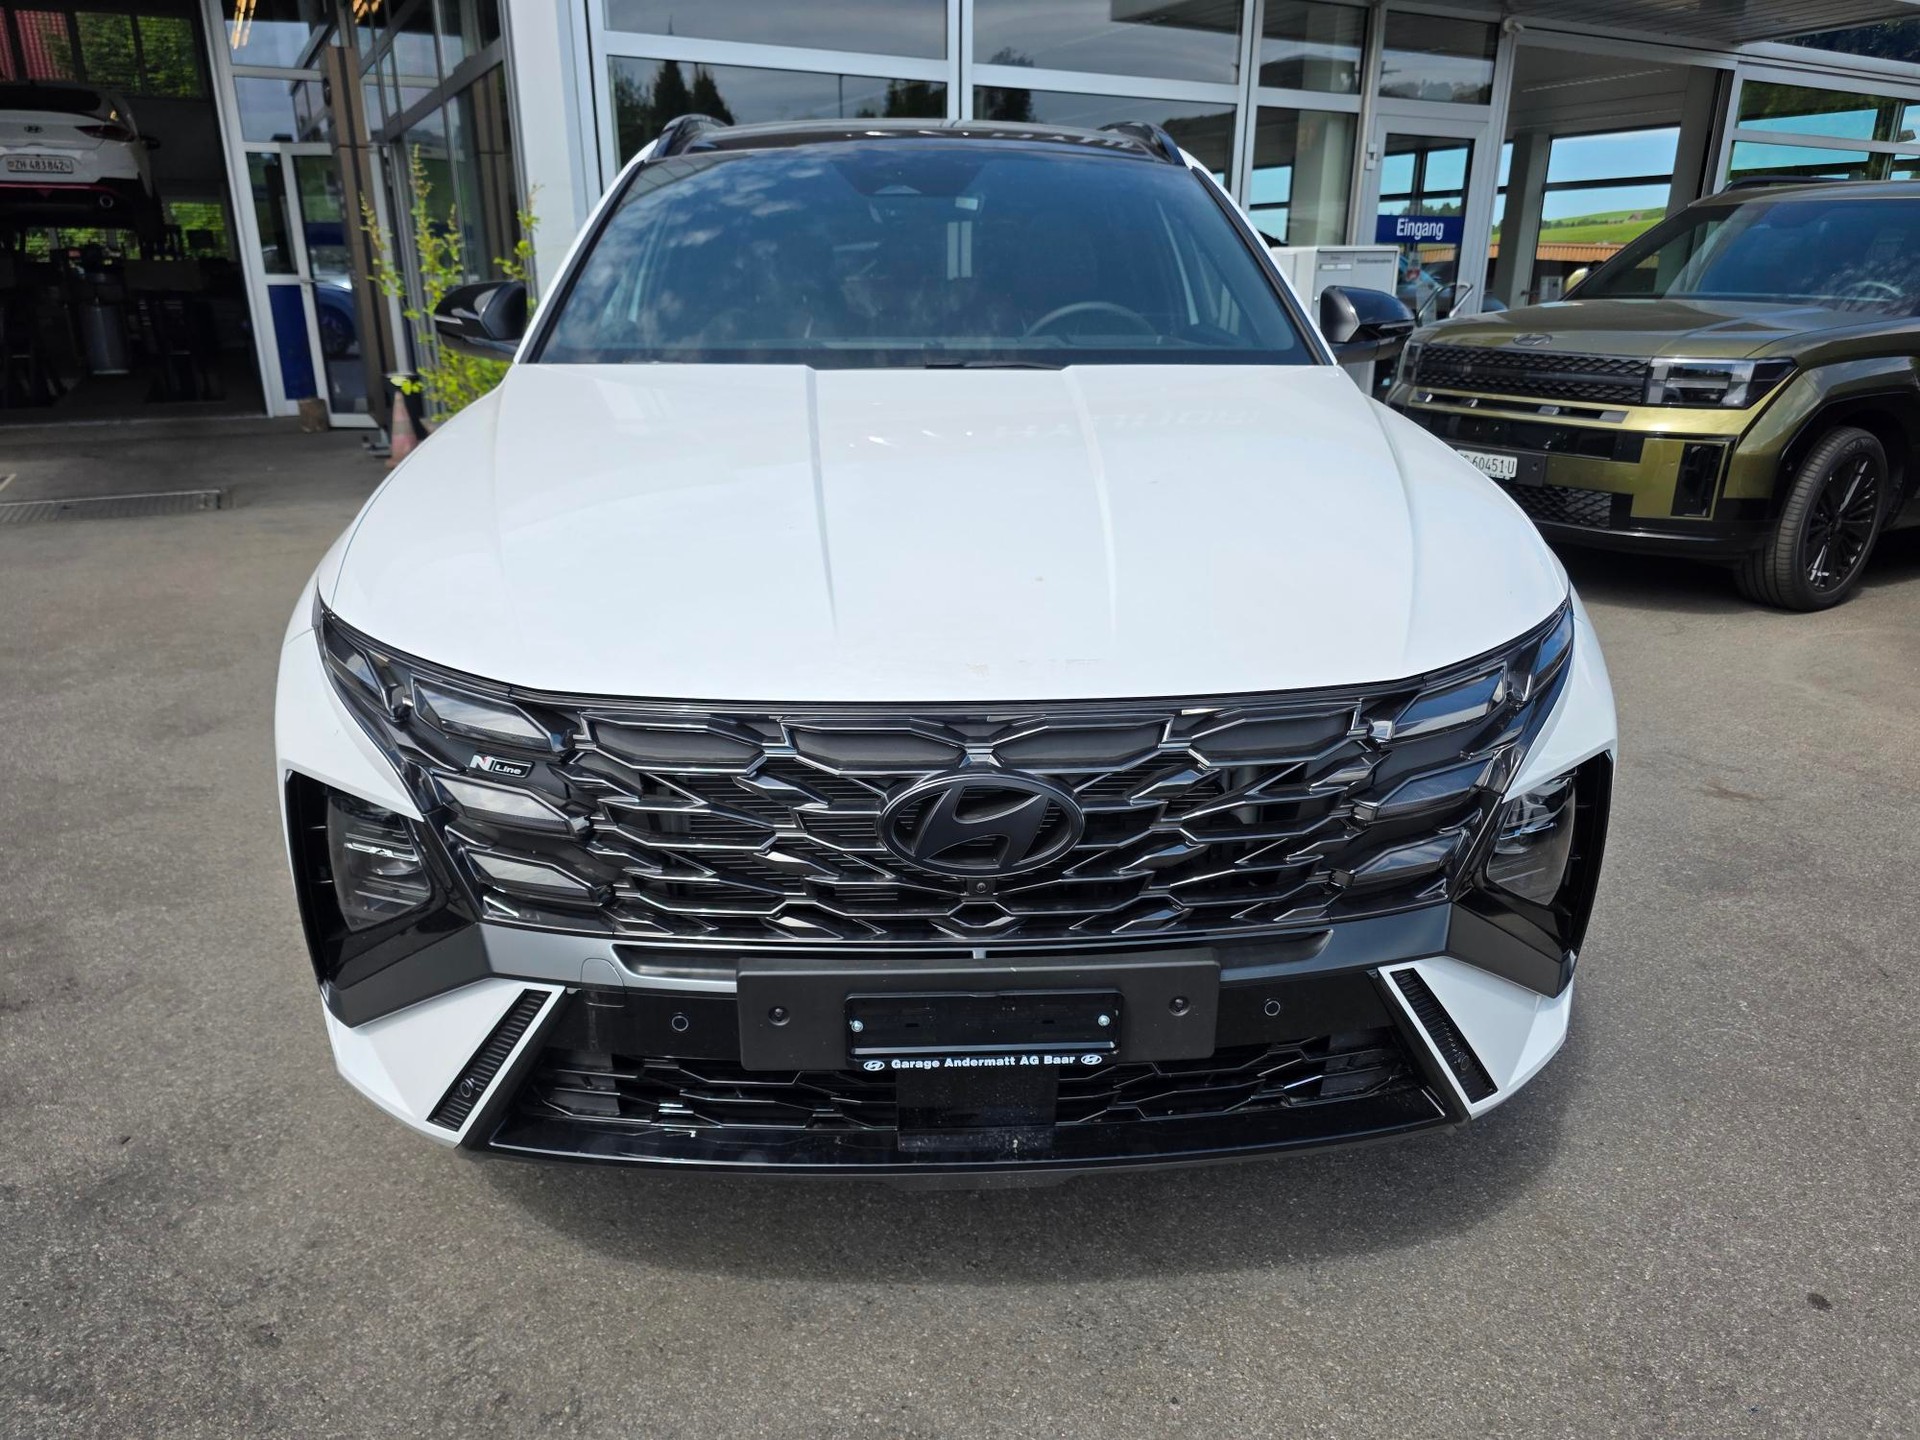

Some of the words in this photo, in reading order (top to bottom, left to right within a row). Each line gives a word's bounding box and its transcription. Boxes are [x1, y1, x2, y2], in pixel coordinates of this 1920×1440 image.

[1396, 218, 1444, 240] Eingang
[495, 764, 522, 775] Line
[891, 1059, 940, 1070] Garage
[944, 1056, 1016, 1068] Andermatt
[1020, 1055, 1039, 1066] AG
[1044, 1055, 1075, 1065] Baar
